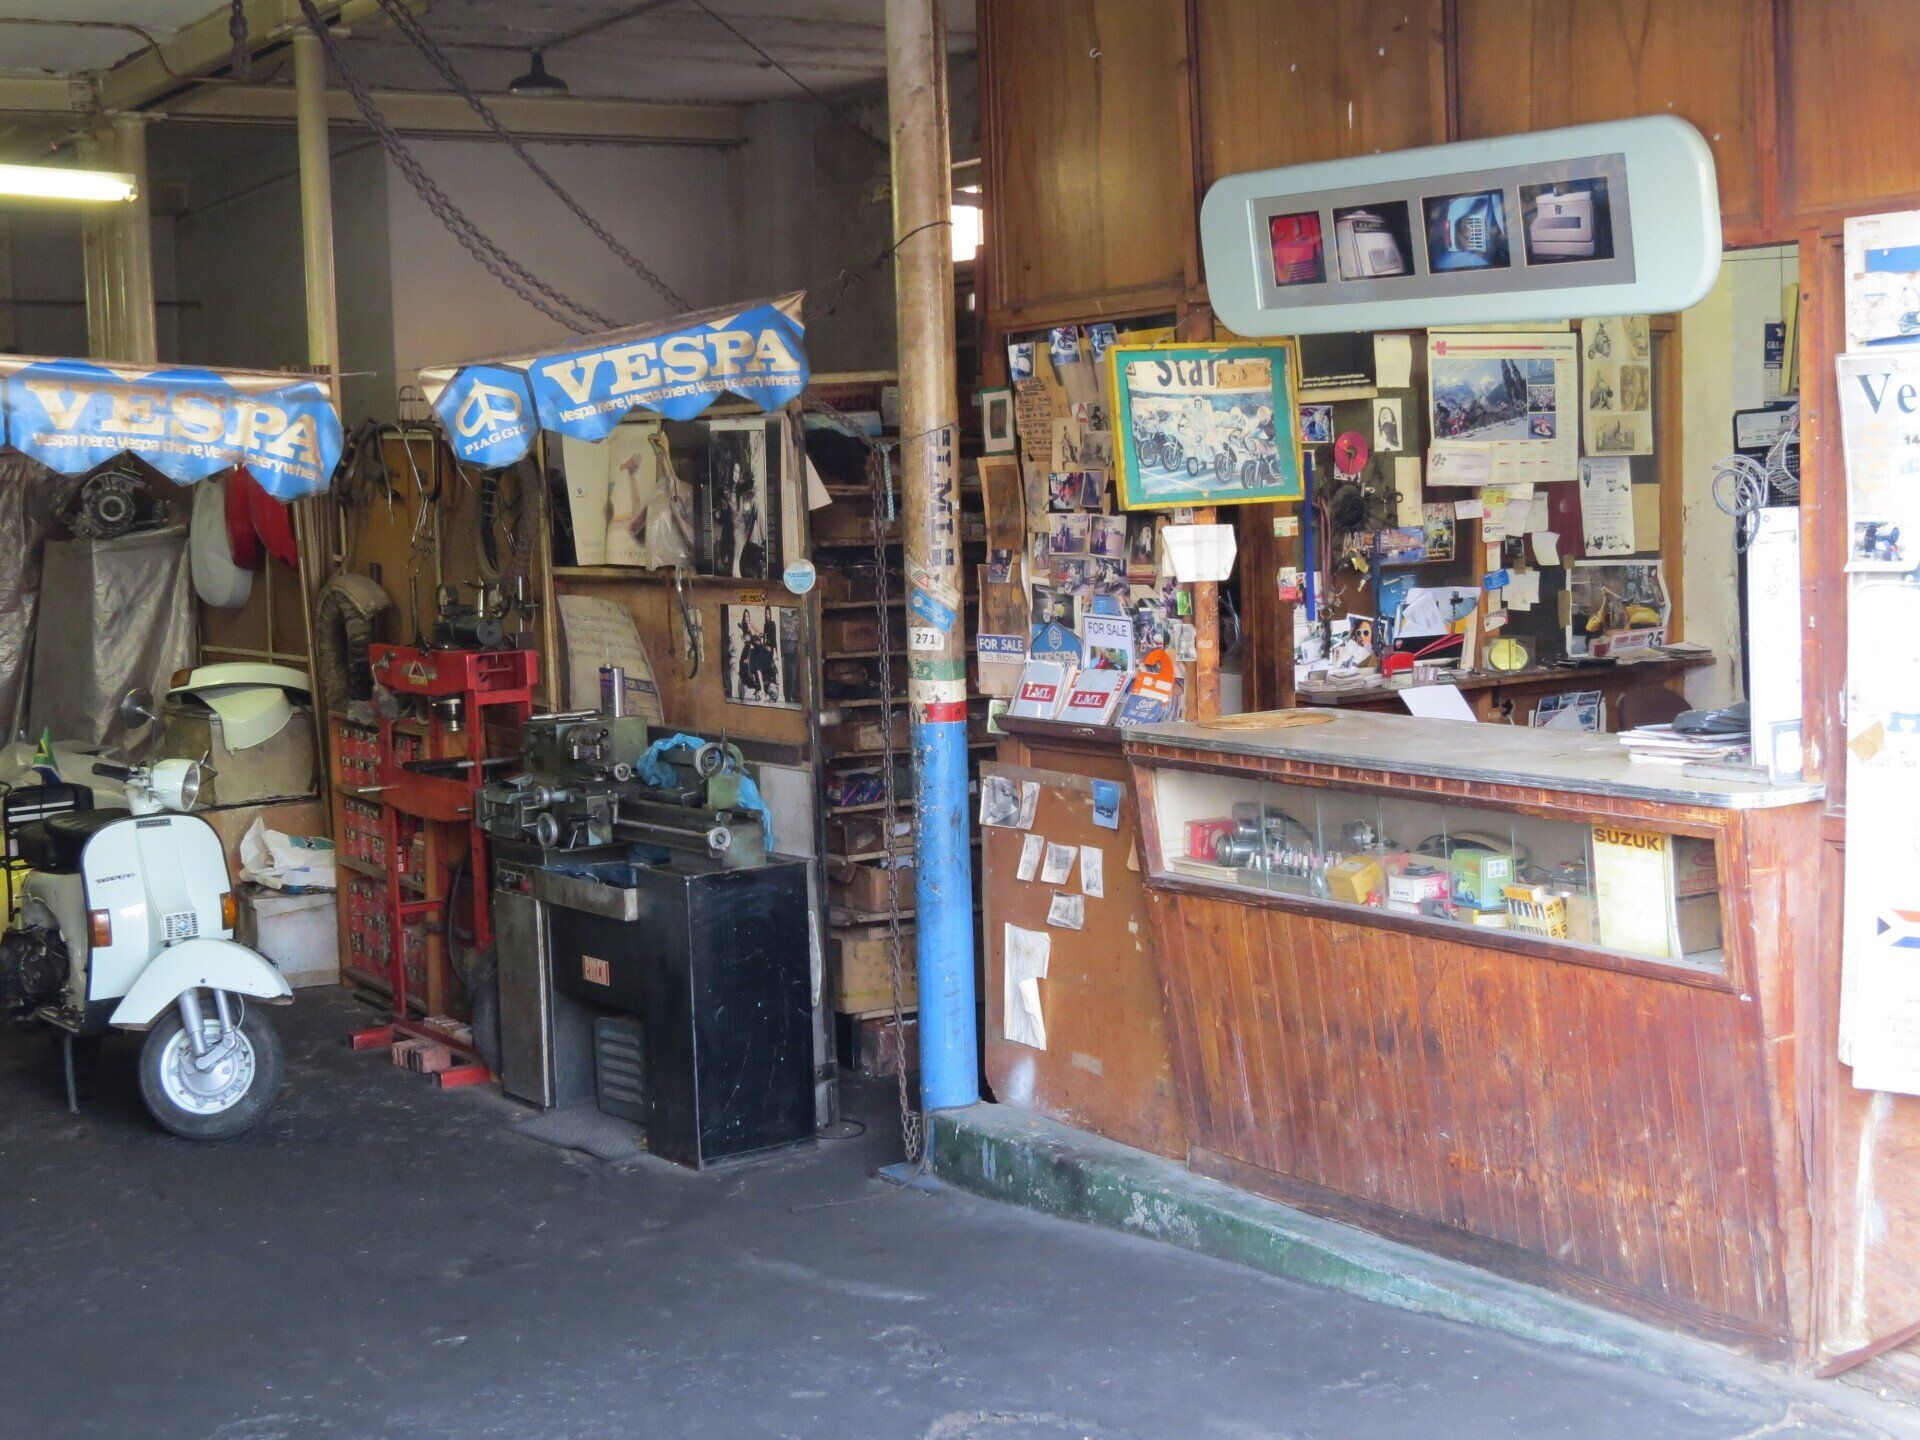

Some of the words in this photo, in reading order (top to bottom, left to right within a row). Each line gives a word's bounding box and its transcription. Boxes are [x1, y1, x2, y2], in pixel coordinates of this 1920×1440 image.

[543, 329, 799, 404] VESPA
[25, 380, 324, 473] VESPA
[464, 422, 530, 456] PIAGGIO
[1088, 621, 1106, 634] FOR
[1107, 623, 1128, 638] SALE
[915, 633, 937, 645] 271
[979, 638, 998, 650] FOR
[1000, 639, 1023, 652] SALE
[1024, 687, 1051, 700] LML
[1075, 693, 1103, 706] LML
[1593, 827, 1665, 852] SUZUKI
